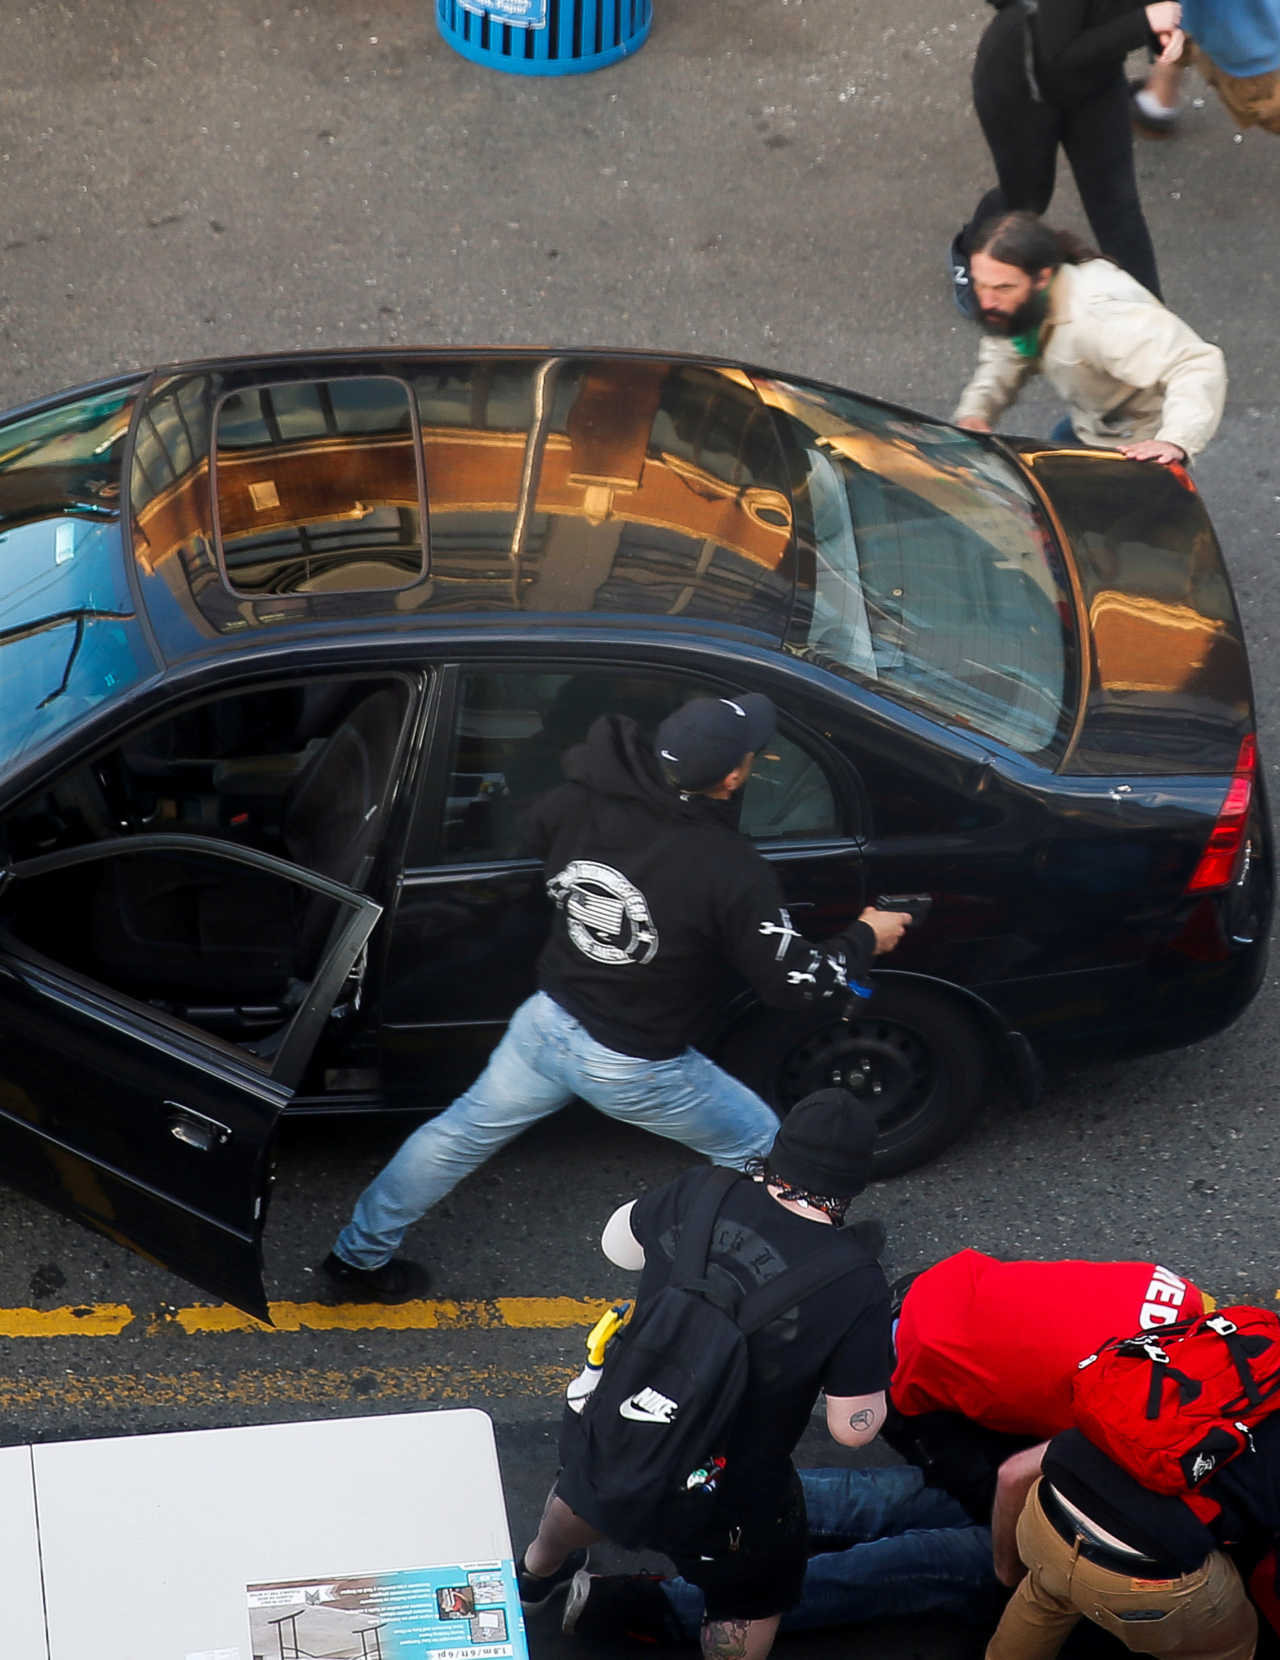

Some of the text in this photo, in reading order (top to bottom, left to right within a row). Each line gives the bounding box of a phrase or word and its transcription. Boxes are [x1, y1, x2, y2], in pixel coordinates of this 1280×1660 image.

[1139, 1265, 1187, 1330] MED
[632, 1386, 679, 1417] NIKE
[493, 1647, 506, 1655] 1.8
